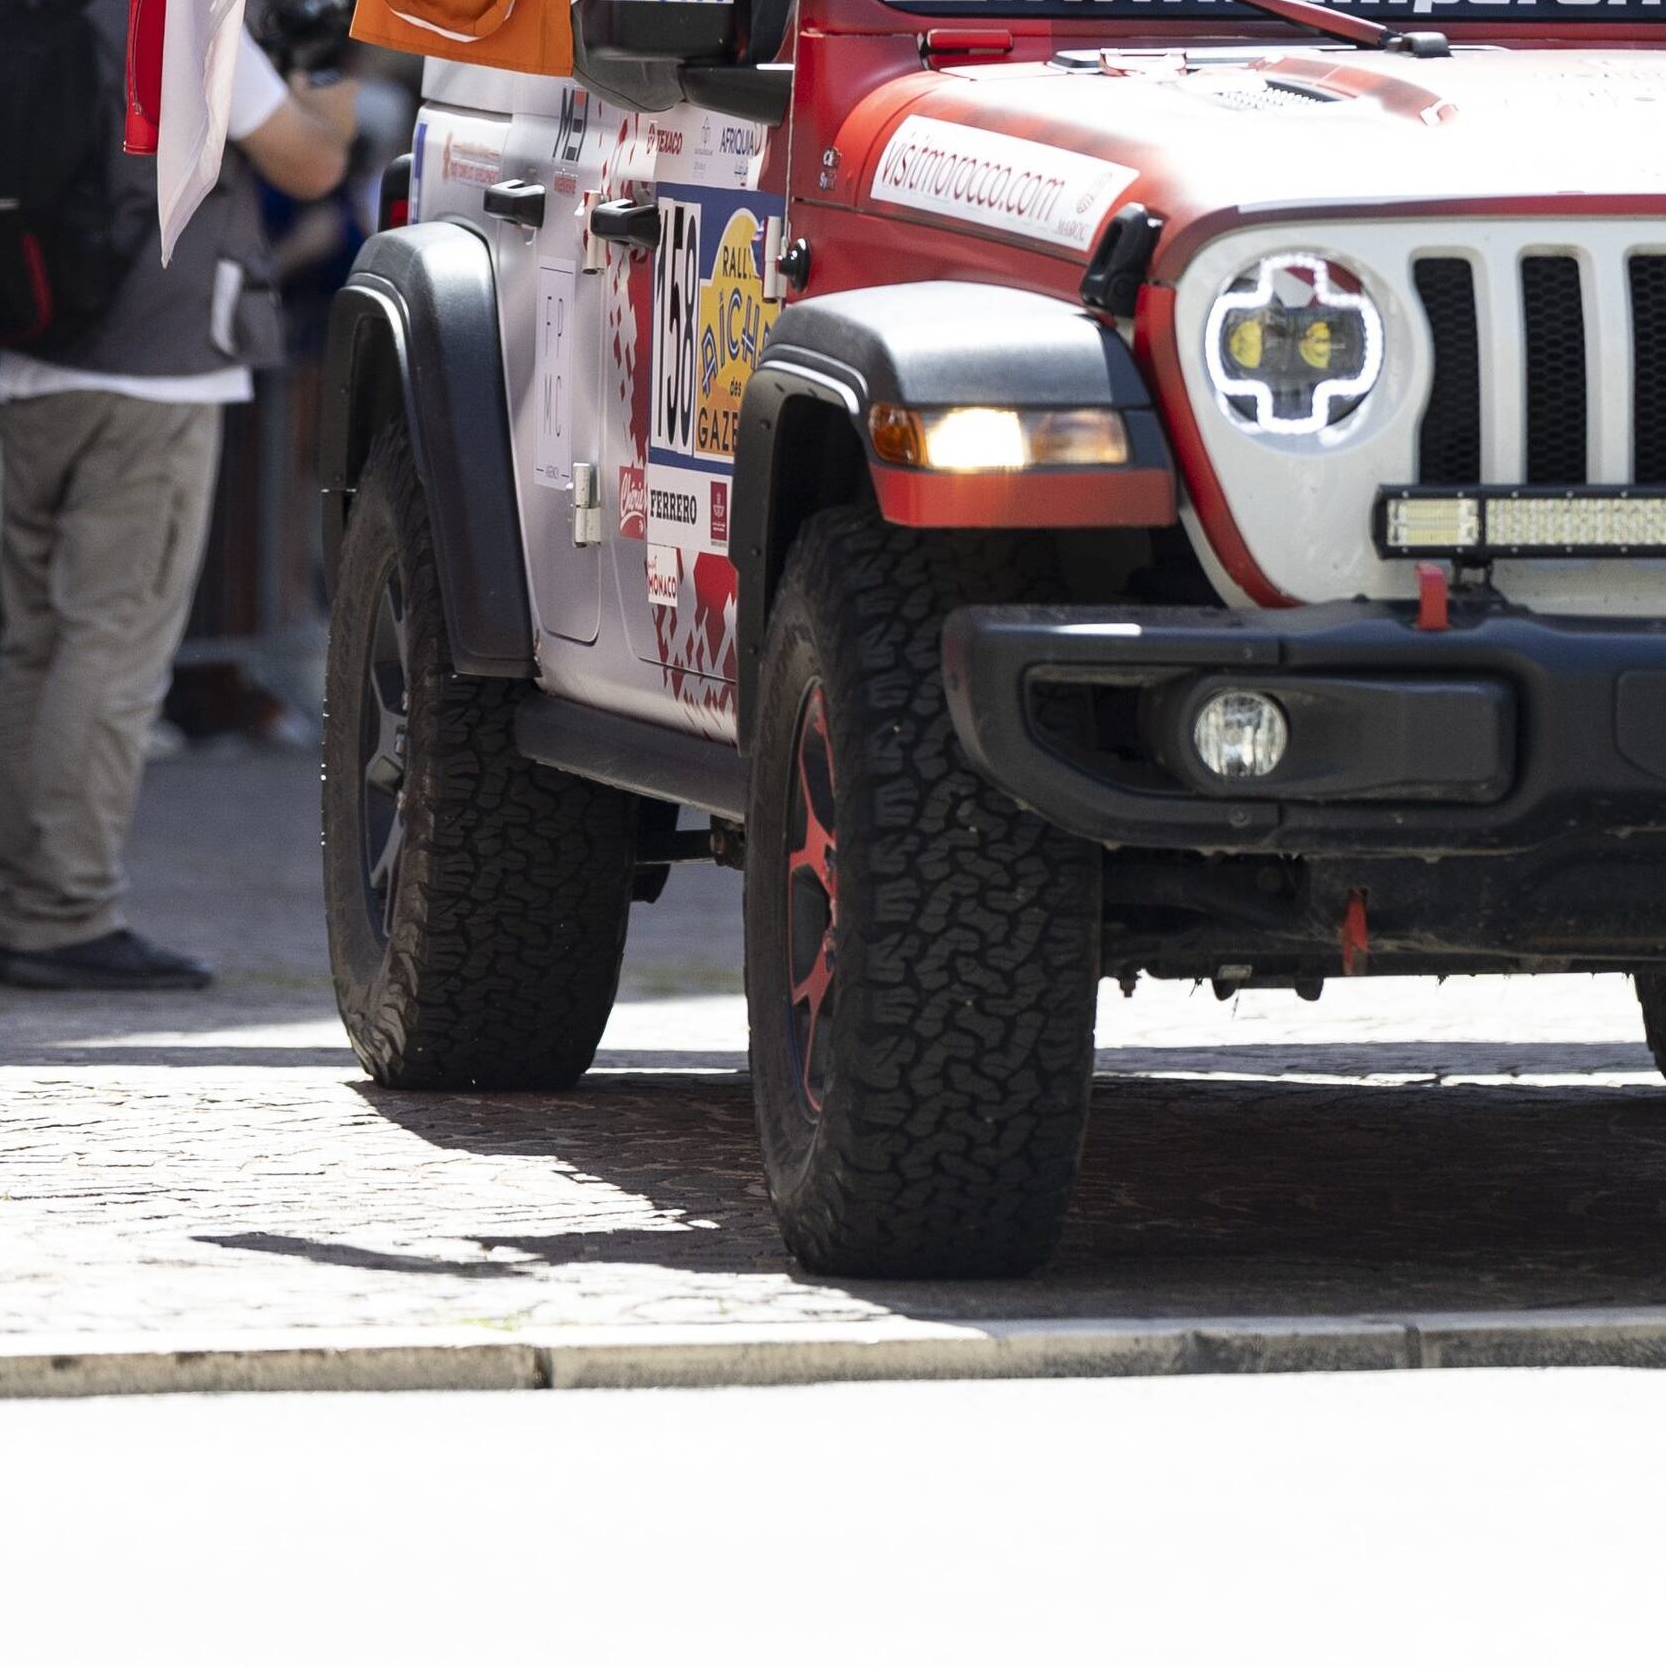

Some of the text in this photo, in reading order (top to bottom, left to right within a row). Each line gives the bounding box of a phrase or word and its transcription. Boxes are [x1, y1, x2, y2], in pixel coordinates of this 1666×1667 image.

[656, 128, 683, 155] TEXACO
[719, 126, 755, 157] AFRIQUIA
[881, 131, 1066, 222] visitmorocco.com
[722, 245, 753, 280] RALL
[655, 206, 697, 448] 158
[729, 376, 742, 398] des
[696, 405, 741, 453] GAZE
[650, 489, 697, 526] FERRERO
[648, 574, 677, 599] MONACO
